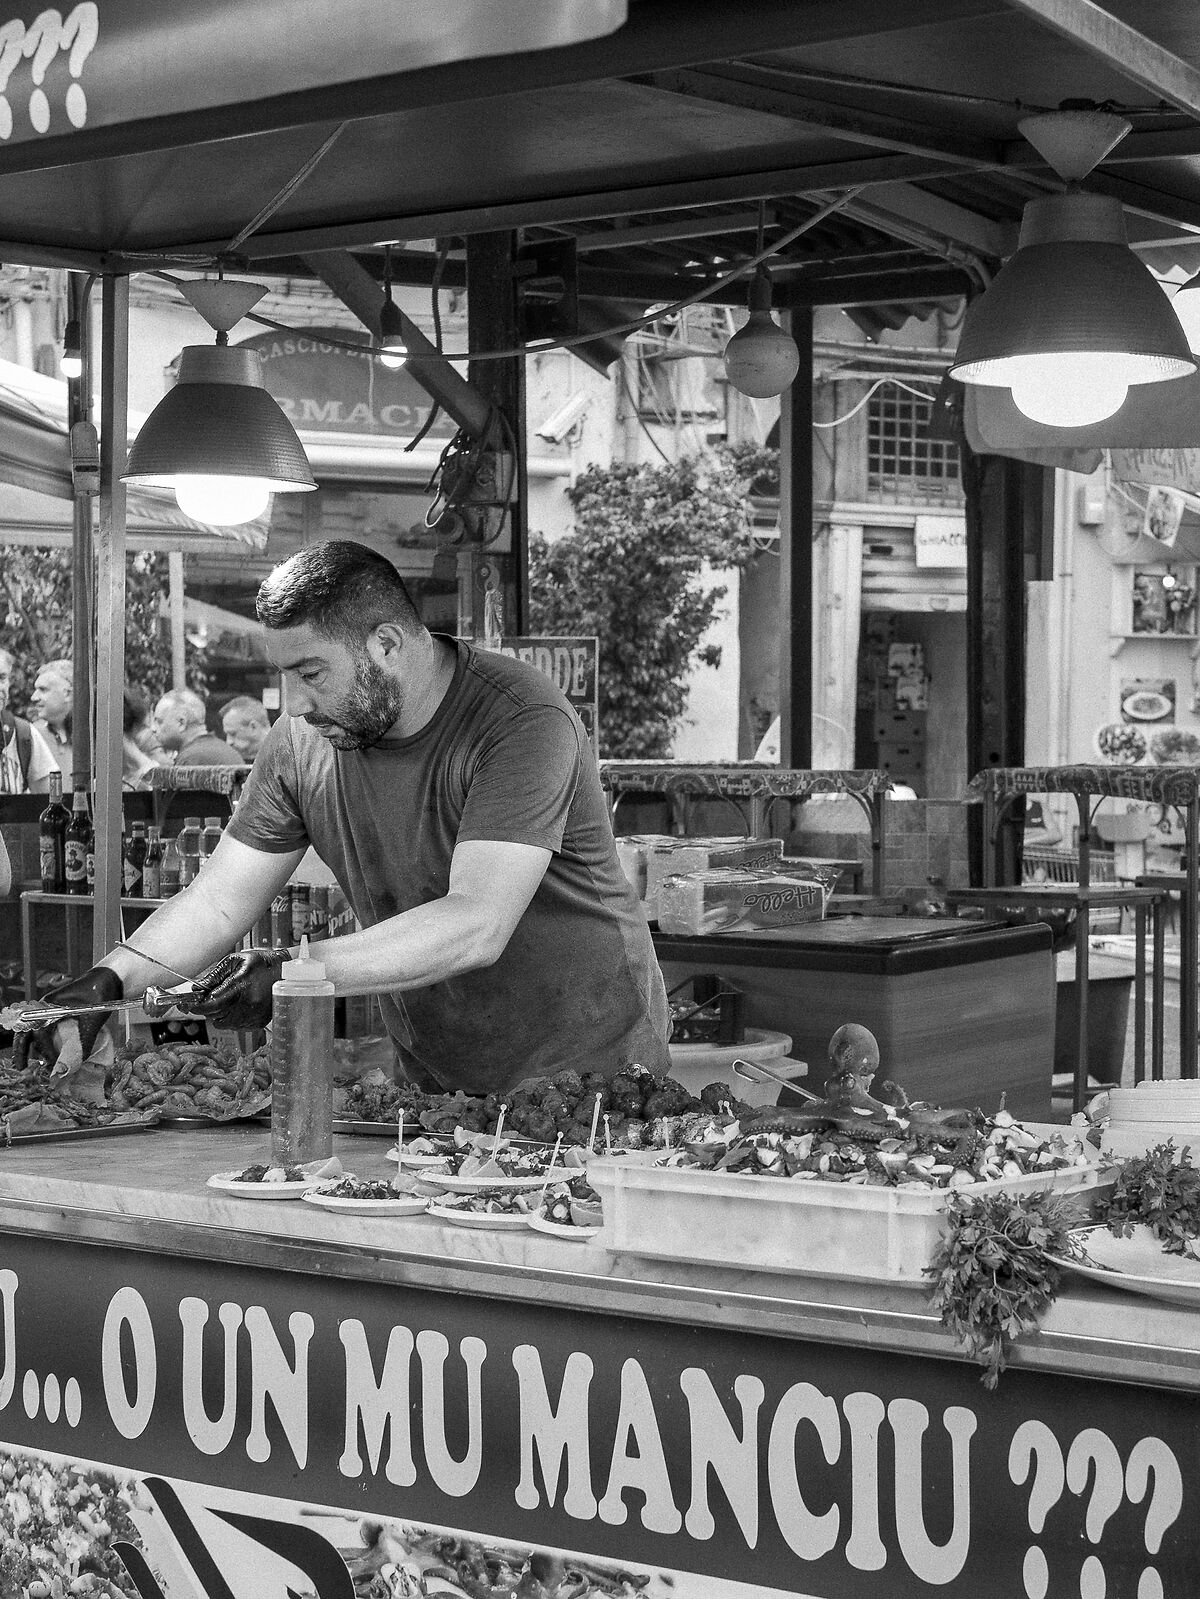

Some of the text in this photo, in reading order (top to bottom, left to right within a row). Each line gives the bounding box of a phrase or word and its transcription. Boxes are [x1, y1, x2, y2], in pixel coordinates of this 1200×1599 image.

[744, 886, 816, 913] Hello
[101, 1286, 157, 1439] O
[179, 1297, 315, 1470] UN
[338, 1318, 487, 1497] MU
[511, 1344, 978, 1585] MANCIU
